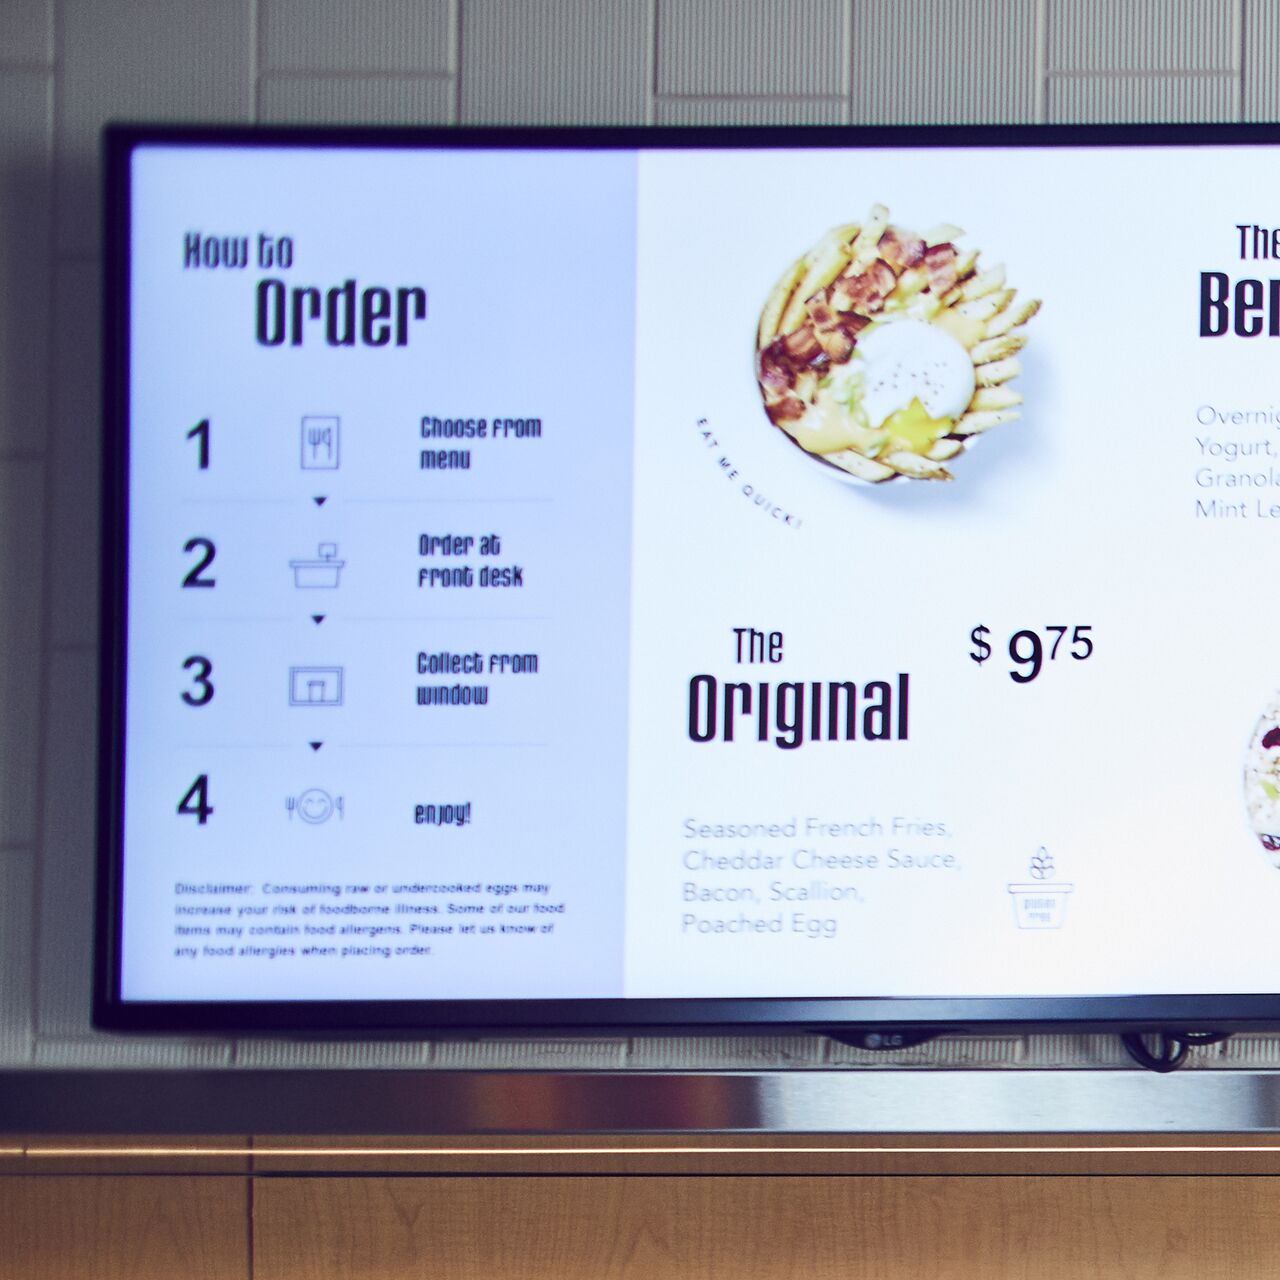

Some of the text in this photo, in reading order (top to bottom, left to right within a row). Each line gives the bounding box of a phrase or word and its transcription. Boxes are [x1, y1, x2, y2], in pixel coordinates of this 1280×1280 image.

[184, 232, 293, 269] How to
[256, 278, 426, 347] Order
[421, 416, 542, 438] Choose from
[187, 419, 210, 470] 1
[1195, 437, 1277, 462] Yogurt,
[420, 450, 471, 470] menu
[1196, 499, 1246, 518] Mint
[419, 533, 501, 556] Order at
[182, 537, 216, 588] 2
[418, 565, 523, 588] front desk
[733, 628, 783, 663] The
[970, 625, 991, 664] $
[417, 651, 538, 674] Collect from
[181, 655, 214, 707] 3
[416, 683, 488, 706] window
[688, 673, 909, 750] Original
[177, 774, 213, 825] 4
[414, 802, 471, 827] enjoy!
[683, 816, 952, 839] Seasoned French Fries,
[682, 848, 960, 871] Cheddar Cheese Sauce,
[261, 881, 342, 898] Consuming
[345, 884, 370, 896] raw
[373, 884, 388, 896] or
[392, 881, 483, 896] undercooked
[485, 884, 518, 898] eggs
[521, 883, 551, 898] may
[682, 881, 863, 903] Bacon, Scallion,
[682, 913, 837, 939] Poached Egg
